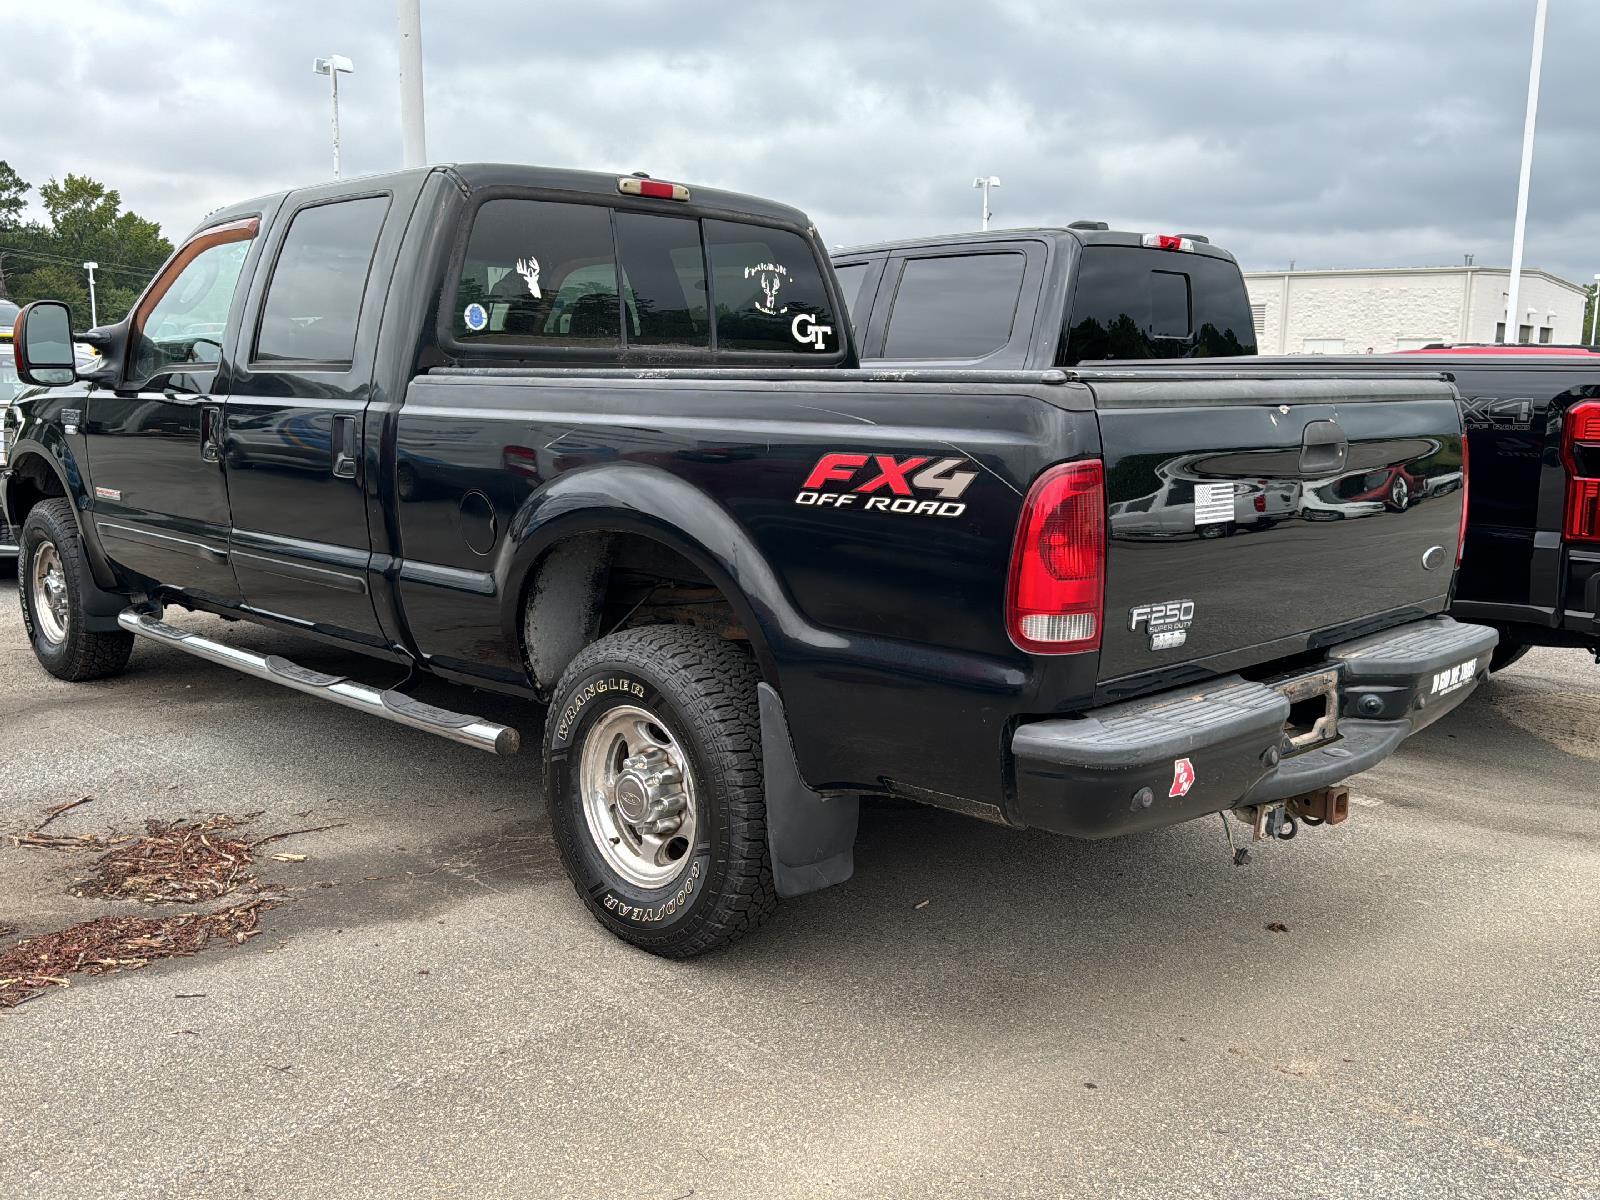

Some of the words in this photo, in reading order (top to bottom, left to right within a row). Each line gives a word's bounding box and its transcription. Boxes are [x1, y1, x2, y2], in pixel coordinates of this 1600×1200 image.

[792, 313, 832, 350] GT
[801, 452, 980, 499] FX4
[795, 491, 857, 508] OFF
[864, 497, 967, 518] ROAD
[1149, 623, 1173, 633] SUPER
[1174, 620, 1192, 630] DUTY
[558, 678, 645, 741] WRANGLER
[603, 861, 700, 922] GOODYEAR
